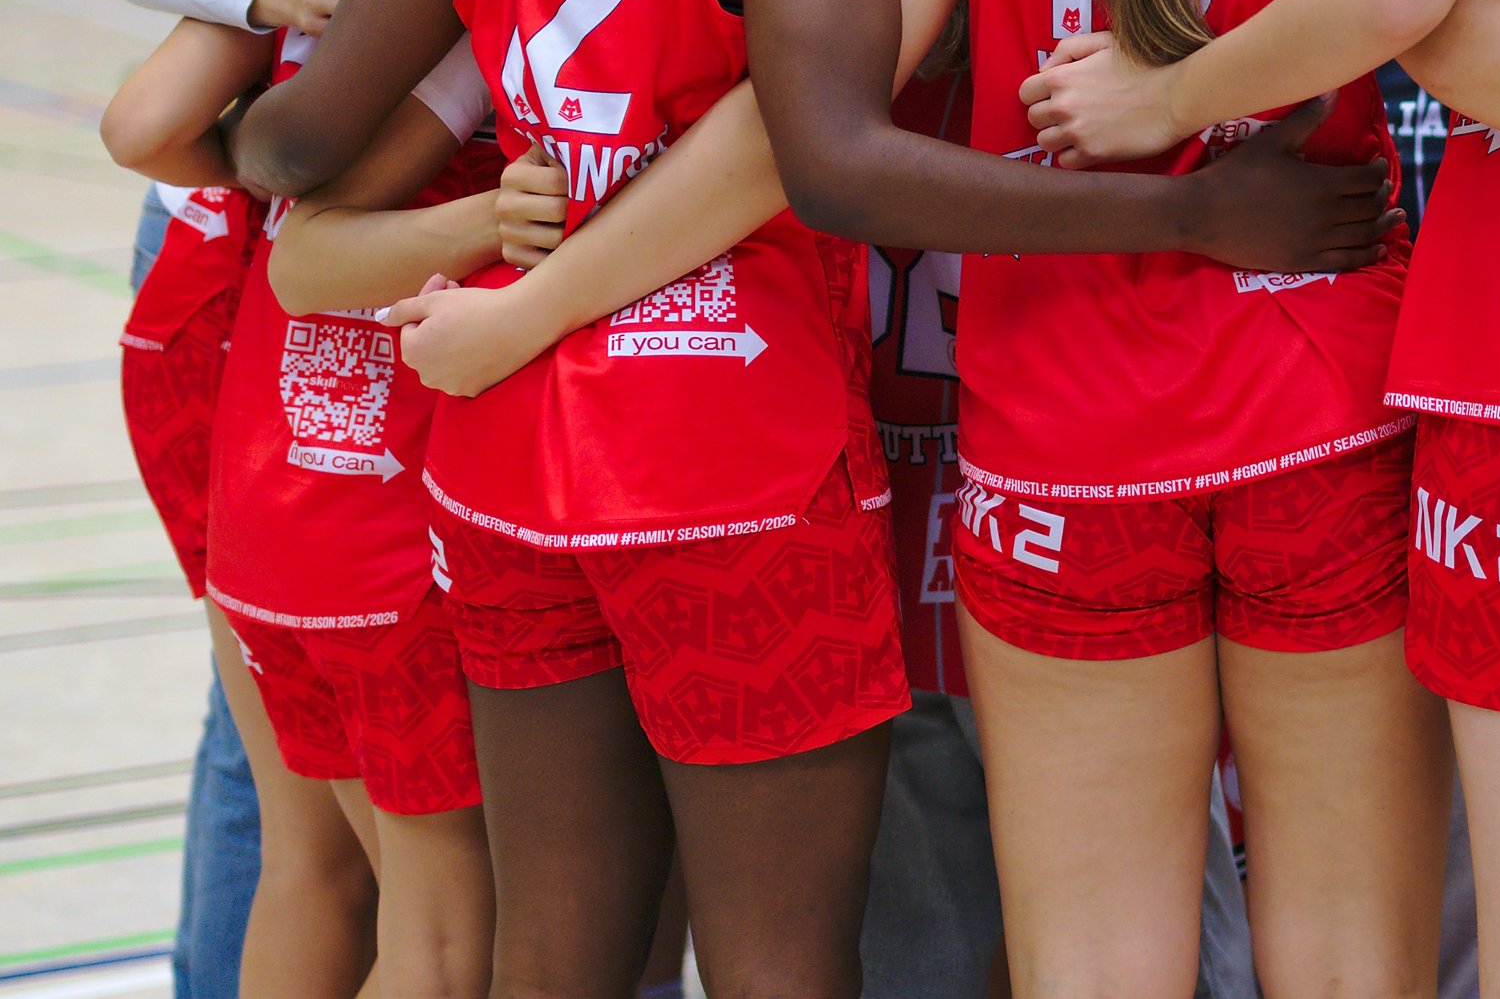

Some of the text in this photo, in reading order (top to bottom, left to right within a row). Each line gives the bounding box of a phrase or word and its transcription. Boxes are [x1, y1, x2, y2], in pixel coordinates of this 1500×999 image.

[183, 204, 210, 228] can
[1236, 272, 1250, 288] if
[611, 335, 737, 356] if you can
[1383, 392, 1484, 418] STRONGERTOGETHER
[331, 455, 375, 472] can
[1003, 477, 1049, 497] #HUSTLE
[1050, 484, 1115, 499] #DEFENSE
[1116, 478, 1192, 498] #INTENSITY
[1194, 470, 1230, 489] #FUN
[1232, 458, 1277, 481] #GROW
[1279, 442, 1331, 469] #FAMILY
[1333, 428, 1379, 453] SEASON
[471, 511, 517, 538] #DEFENSE
[543, 533, 568, 548] #FUN
[570, 533, 619, 548] #GROW
[620, 527, 676, 546] #FAMILY
[676, 524, 726, 542] SEASON
[727, 513, 796, 536] 2025/2026
[302, 616, 337, 629] SEASON
[337, 611, 399, 629] 2025/2026
